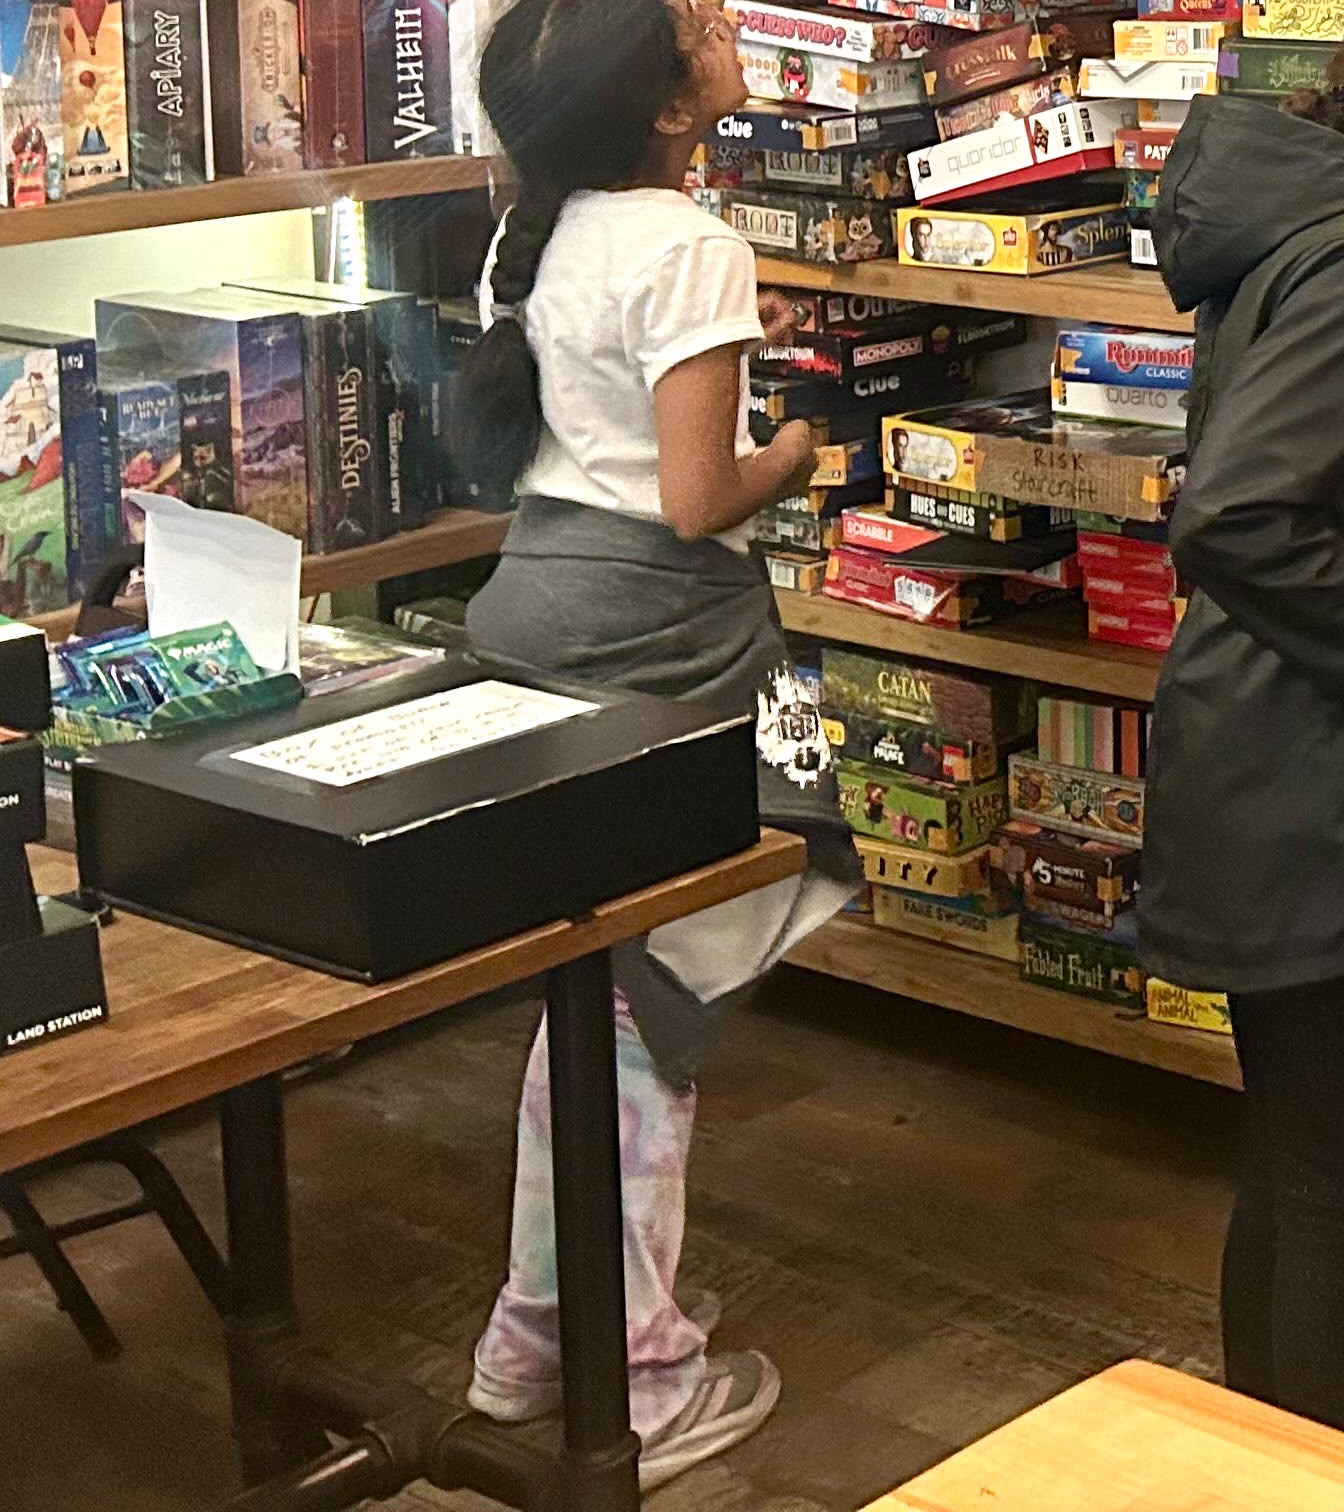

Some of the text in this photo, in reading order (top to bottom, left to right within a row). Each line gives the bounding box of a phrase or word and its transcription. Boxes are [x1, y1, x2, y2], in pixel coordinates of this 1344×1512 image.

[393, 6, 438, 151] VALHEIM
[717, 116, 753, 139] Clue
[947, 137, 1024, 175] quoridor
[734, 206, 795, 237] ROOT
[856, 338, 922, 364] MONOPOLY
[854, 375, 901, 398] Clue
[1145, 367, 1187, 380] CLASSIC
[340, 366, 364, 491] DESTINIES
[1032, 449, 1085, 471] RISK
[1013, 473, 1098, 502] Starcraft
[910, 495, 976, 527] HUES CUES
[845, 519, 894, 543] SCRABBLE
[878, 671, 932, 704] CATAN
[1024, 942, 1104, 990] Fabled Fruit
[6, 1005, 104, 1048] LAND STATION
